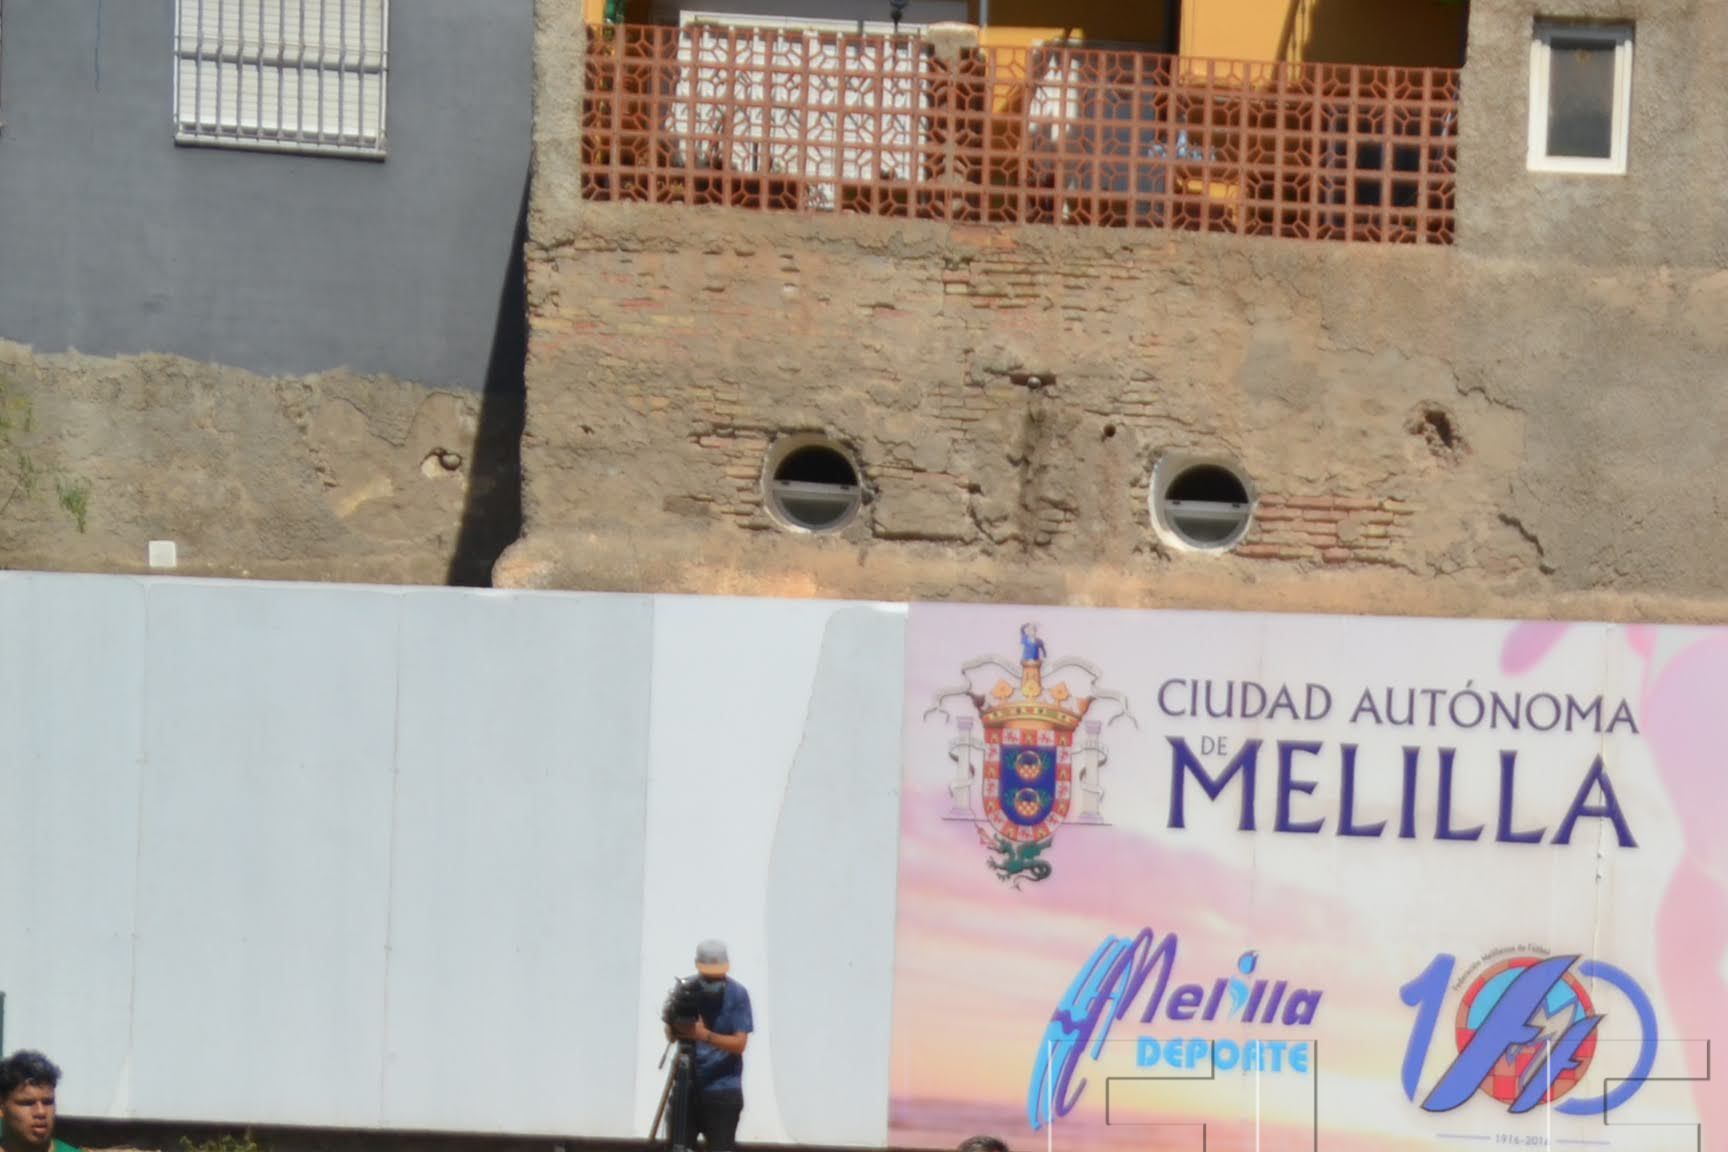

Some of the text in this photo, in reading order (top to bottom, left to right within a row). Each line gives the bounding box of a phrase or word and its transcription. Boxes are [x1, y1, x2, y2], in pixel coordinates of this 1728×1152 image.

[1157, 677, 1641, 735] CIUDAD AUTÓNOMA
[1199, 735, 1229, 757] DE
[1164, 735, 1640, 849] MELILLA
[1136, 1035, 1311, 1074] DEPORTE
